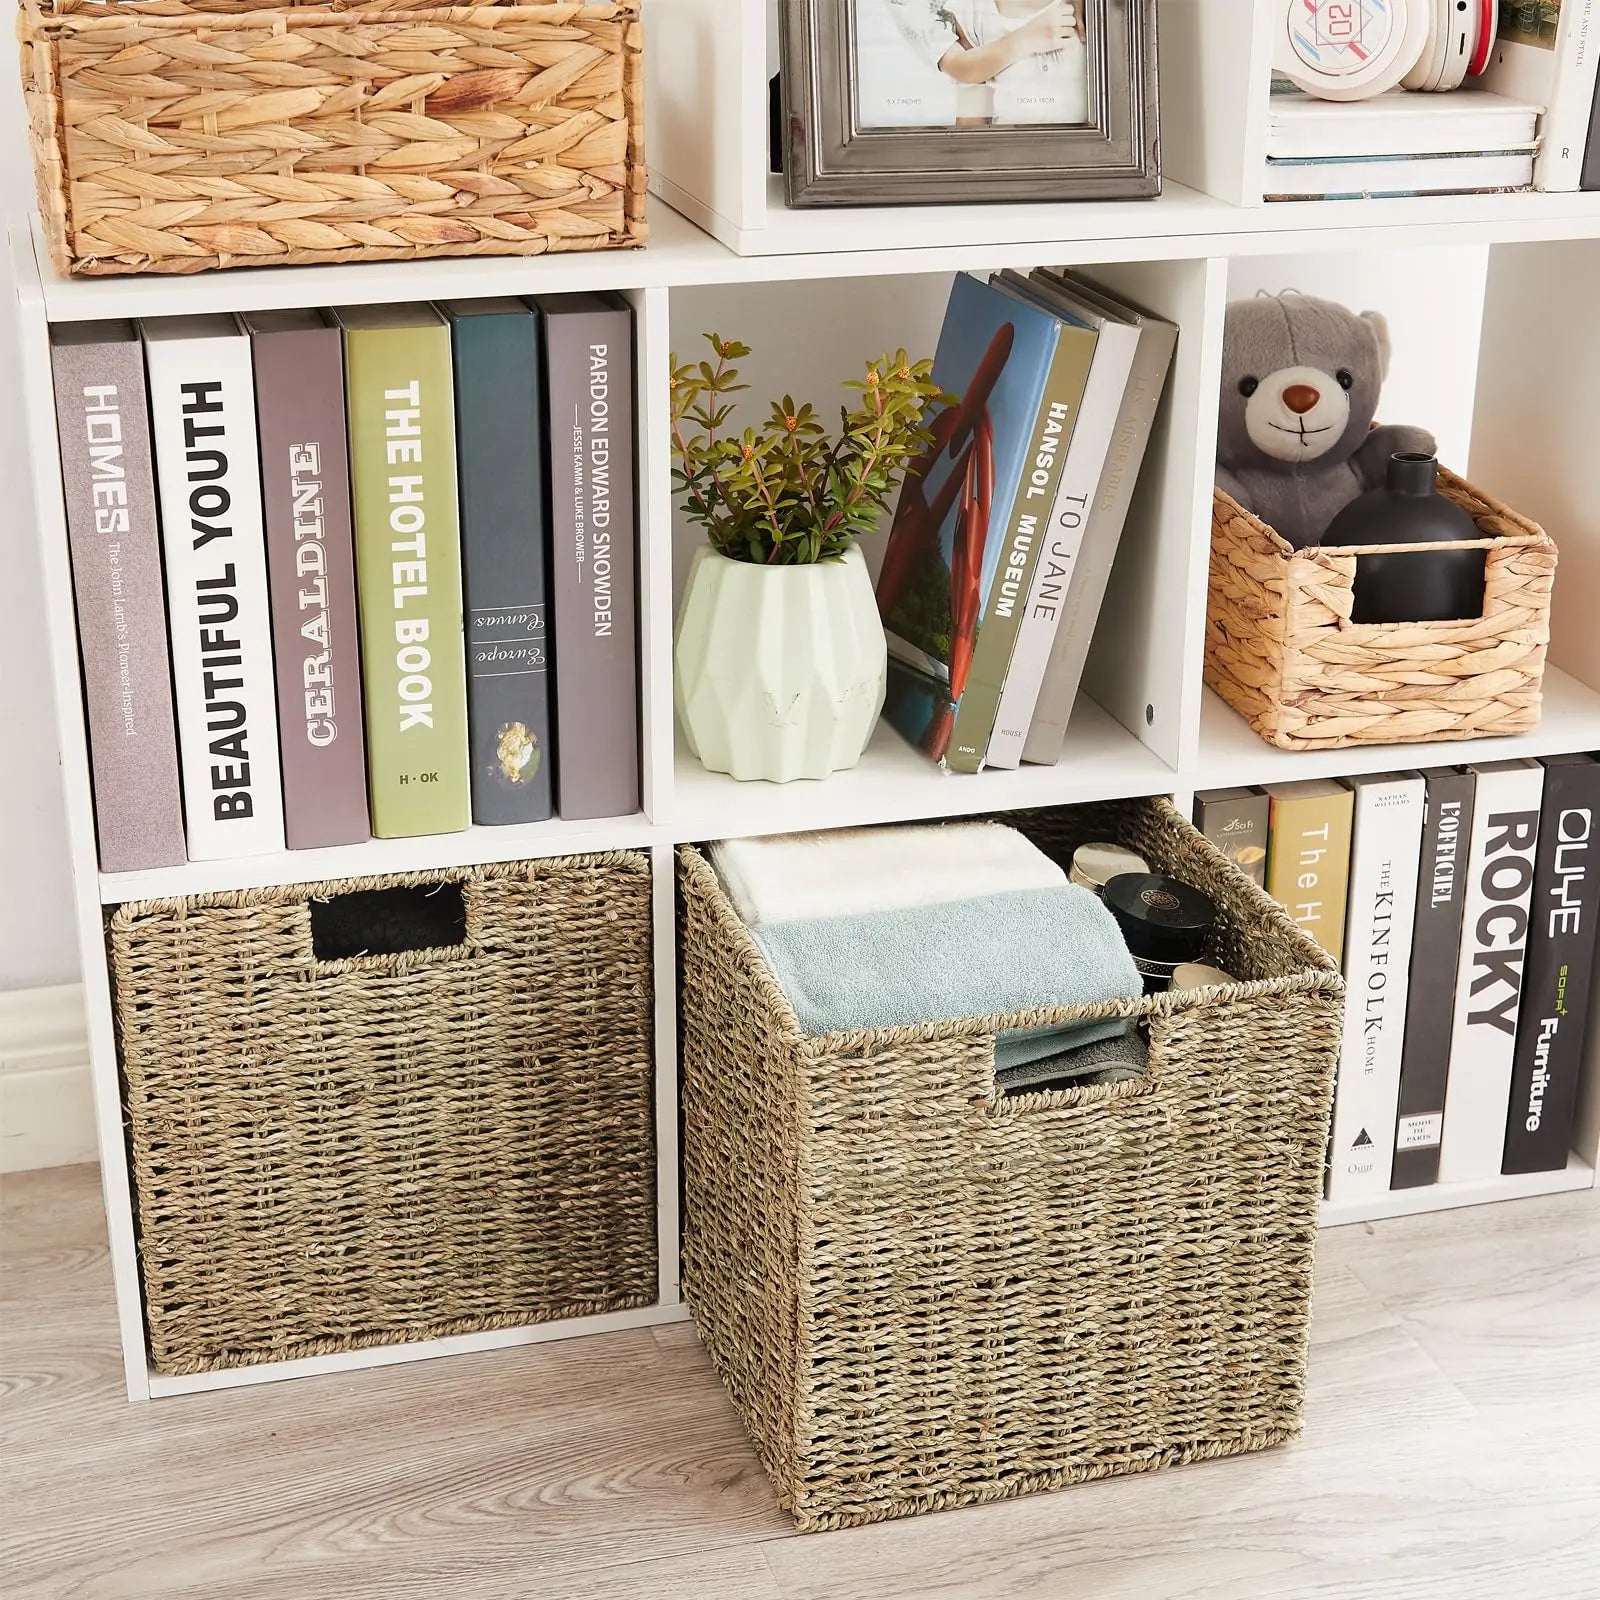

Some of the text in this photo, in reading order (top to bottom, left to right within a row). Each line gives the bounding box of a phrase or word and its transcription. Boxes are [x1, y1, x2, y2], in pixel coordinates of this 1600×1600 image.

[1328, 3, 1353, 36] 02
[1580, 18, 1589, 38] AND
[1575, 39, 1585, 68] STYLE
[1561, 147, 1570, 159] R
[83, 384, 131, 534] HOMES
[589, 343, 612, 637] PARDON EDWARD SNOWDEN
[573, 424, 585, 563] JESSE KAMM & LUKE BROWER
[994, 400, 1069, 618] HANSOL MUSEUM
[1059, 491, 1090, 531] TO
[383, 379, 434, 732] THE HOTEL BOOK
[1032, 540, 1073, 623] JANE
[181, 380, 255, 820] BEAUTIFUL YOUTH
[288, 442, 339, 747] CERALDINE
[473, 612, 546, 632] Canvas
[109, 541, 137, 736] The John Lamb's Pioneer-Inspired
[474, 645, 546, 666] Europe
[958, 745, 976, 754] ANDO
[1000, 728, 1024, 738] HOUSE
[1374, 799, 1411, 808] WILLIAMS
[1378, 792, 1408, 802] NATHAN
[1297, 822, 1329, 889] The
[1431, 801, 1461, 909] L'OFFICIEL
[1548, 807, 1593, 939] OUYE
[1466, 809, 1540, 1037] ROCKY
[1363, 859, 1394, 1077] THE KINFOLK HOME
[1525, 1016, 1560, 1133] Furniture
[1406, 1134, 1432, 1143] PARIS
[1407, 1119, 1432, 1128] MODE
[1413, 1127, 1424, 1135] DE
